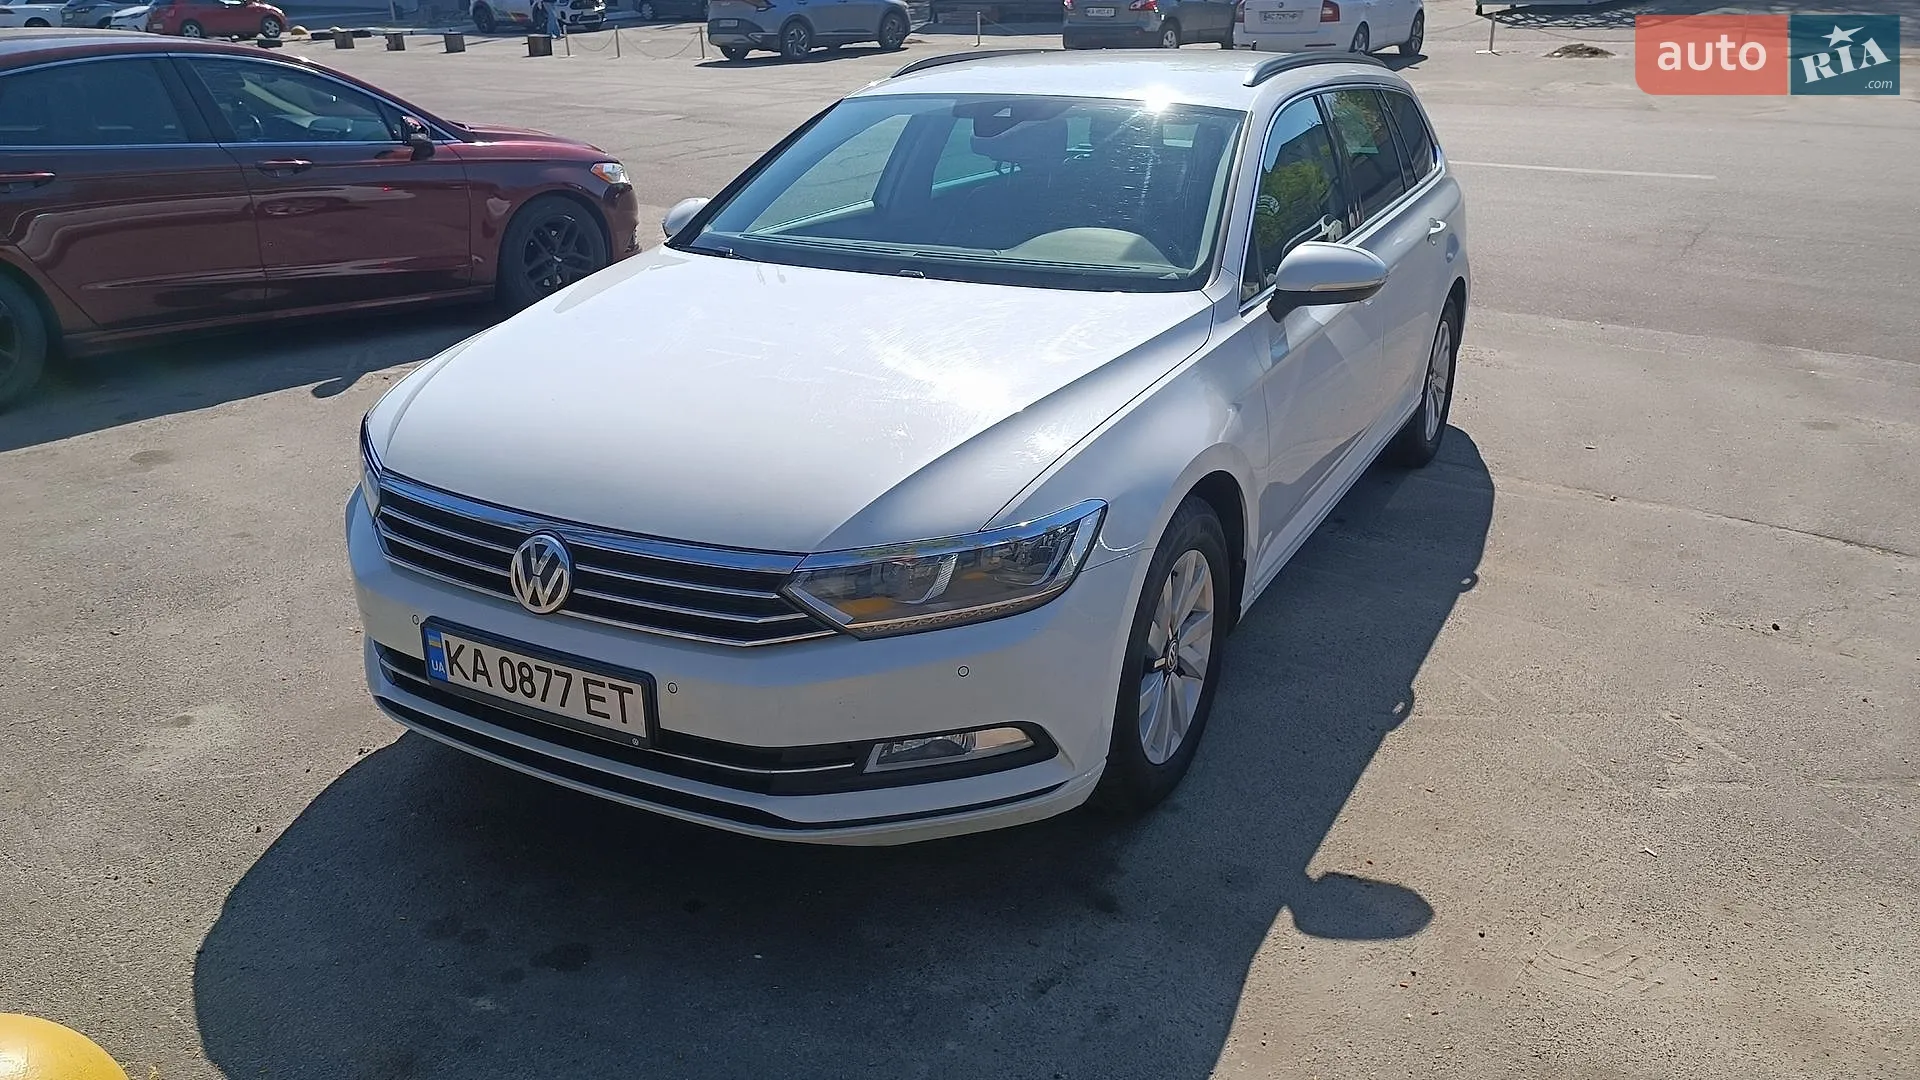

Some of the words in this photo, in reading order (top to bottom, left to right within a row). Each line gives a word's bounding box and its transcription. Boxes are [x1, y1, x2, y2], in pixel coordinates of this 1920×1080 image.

[431, 659, 446, 673] UA
[444, 640, 493, 688] KA
[498, 656, 573, 708] 0877
[582, 677, 634, 724] ET
